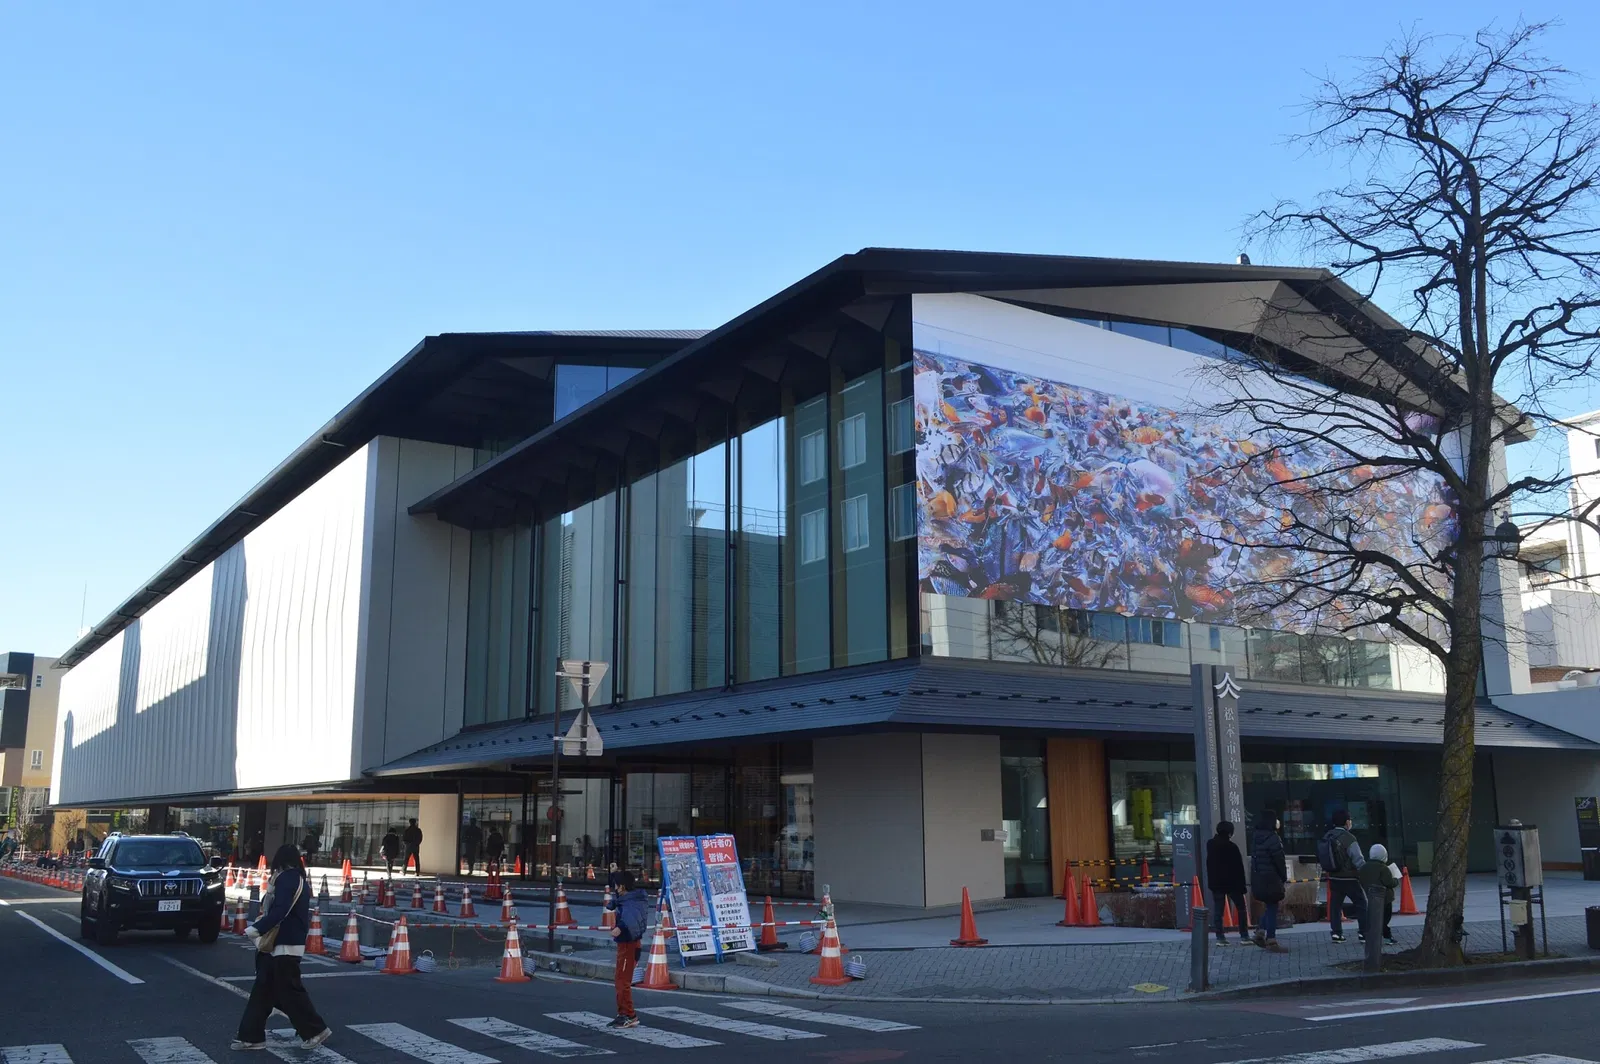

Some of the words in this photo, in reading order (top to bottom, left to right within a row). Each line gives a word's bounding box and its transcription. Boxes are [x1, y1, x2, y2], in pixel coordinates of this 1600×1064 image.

[1207, 706, 1215, 752] Matsumoto
[1224, 707, 1241, 823] 松本市立博物館
[703, 838, 732, 849] 歩行者の
[708, 852, 732, 863] 皆様へ
